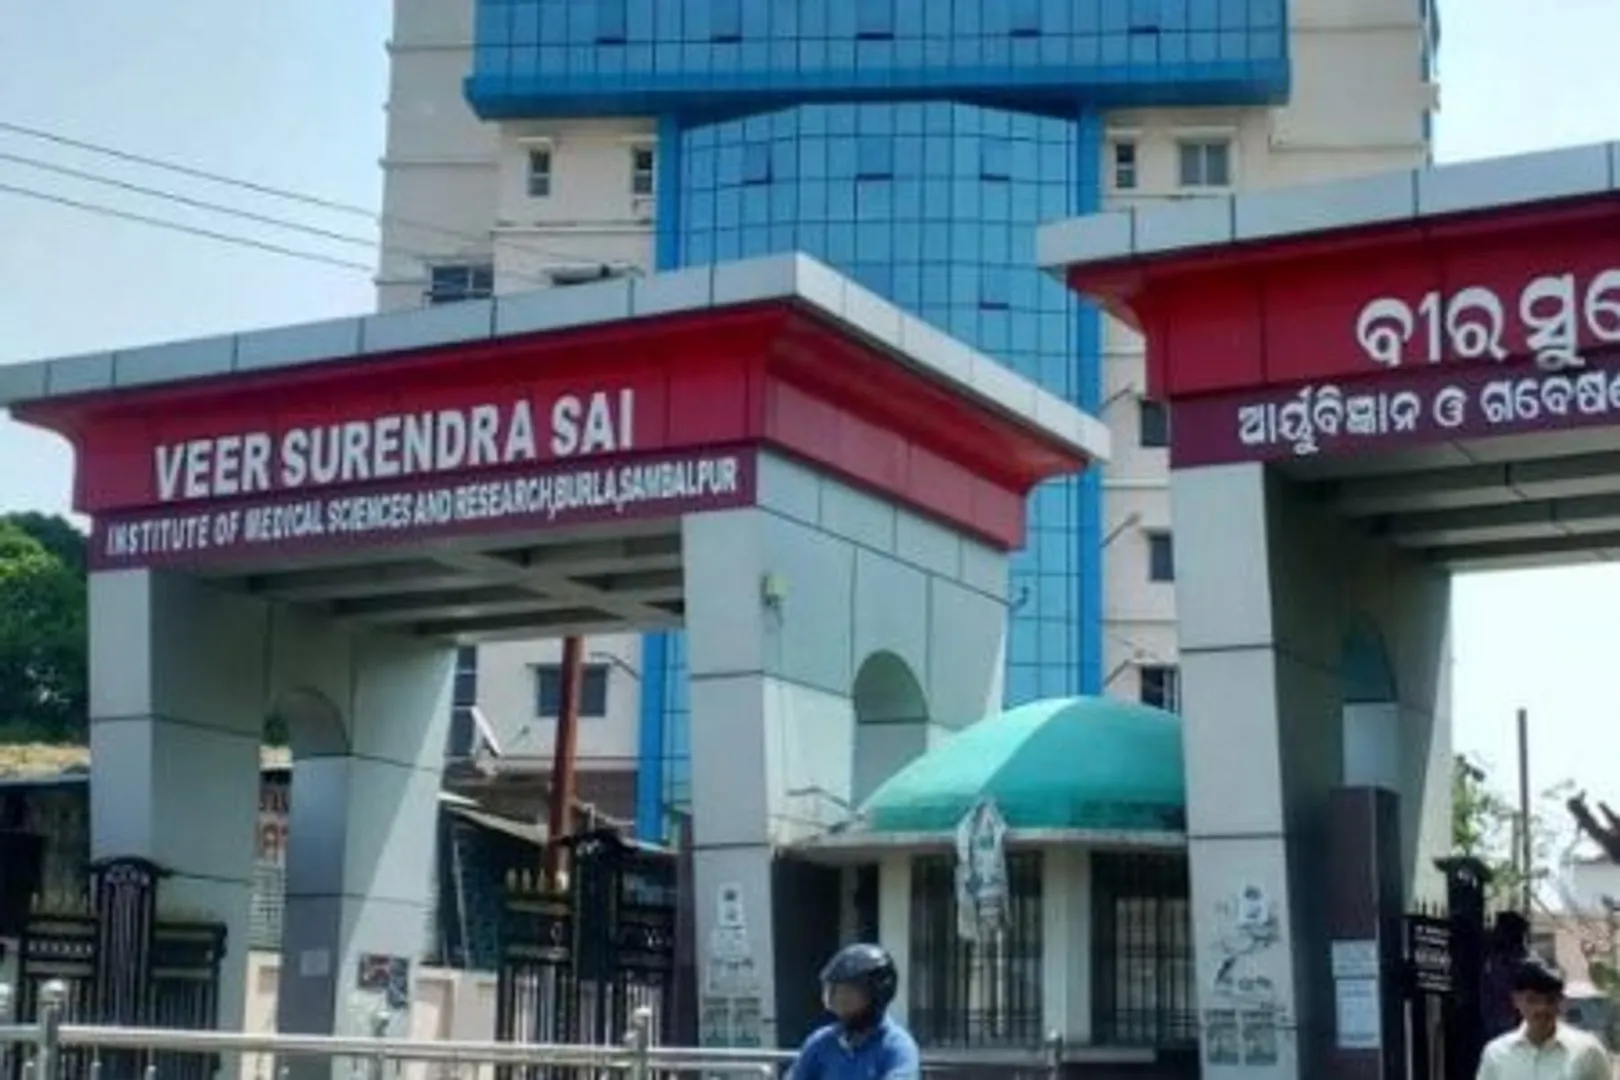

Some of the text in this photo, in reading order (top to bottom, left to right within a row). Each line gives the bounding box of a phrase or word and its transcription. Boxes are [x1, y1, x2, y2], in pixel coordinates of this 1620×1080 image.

[154, 389, 634, 502] VEER SURENDRA SAI
[107, 514, 210, 556] INSTITUTE
[214, 511, 240, 545] OF
[245, 500, 325, 542] MEDICAL
[327, 493, 412, 533] SCIENCES
[414, 489, 451, 523] AND
